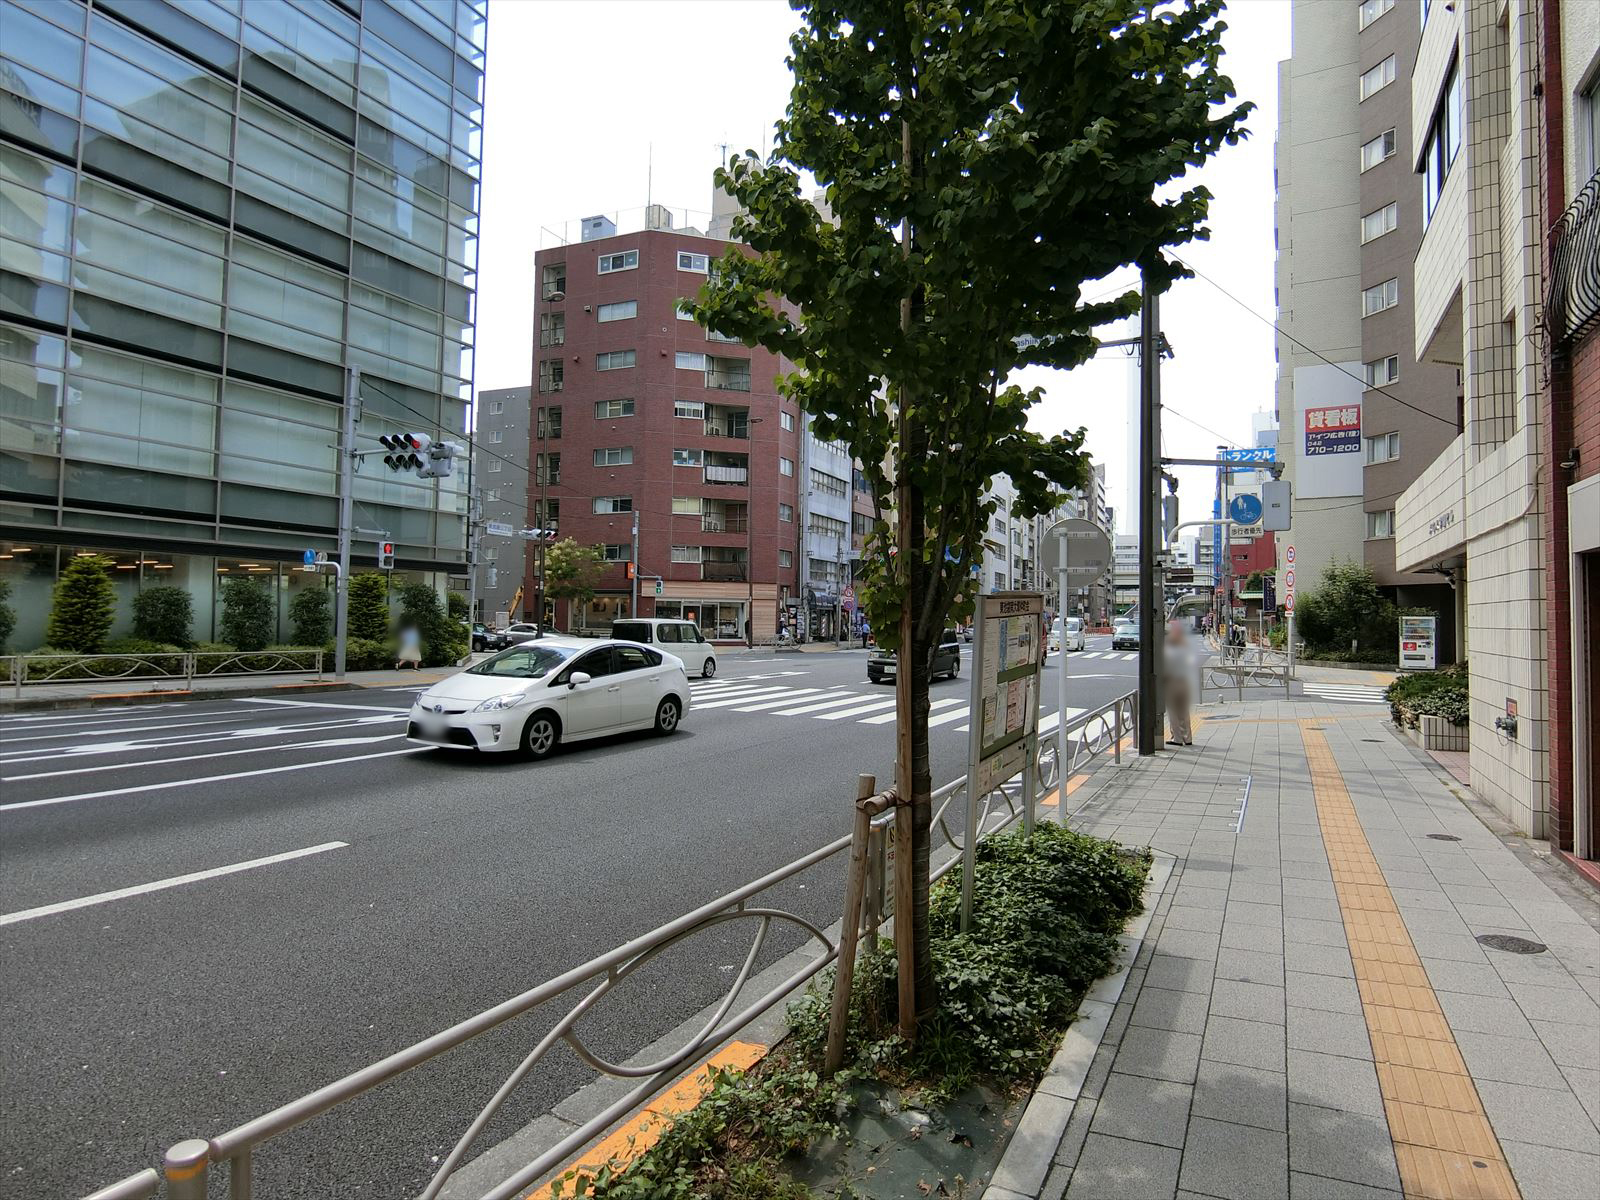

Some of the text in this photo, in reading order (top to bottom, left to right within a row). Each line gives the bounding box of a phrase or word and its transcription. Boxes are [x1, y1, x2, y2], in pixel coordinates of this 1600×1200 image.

[1308, 408, 1358, 428] 貸看板
[1308, 444, 1360, 454] 710-1200
[1231, 527, 1262, 536] 歩行者優先
